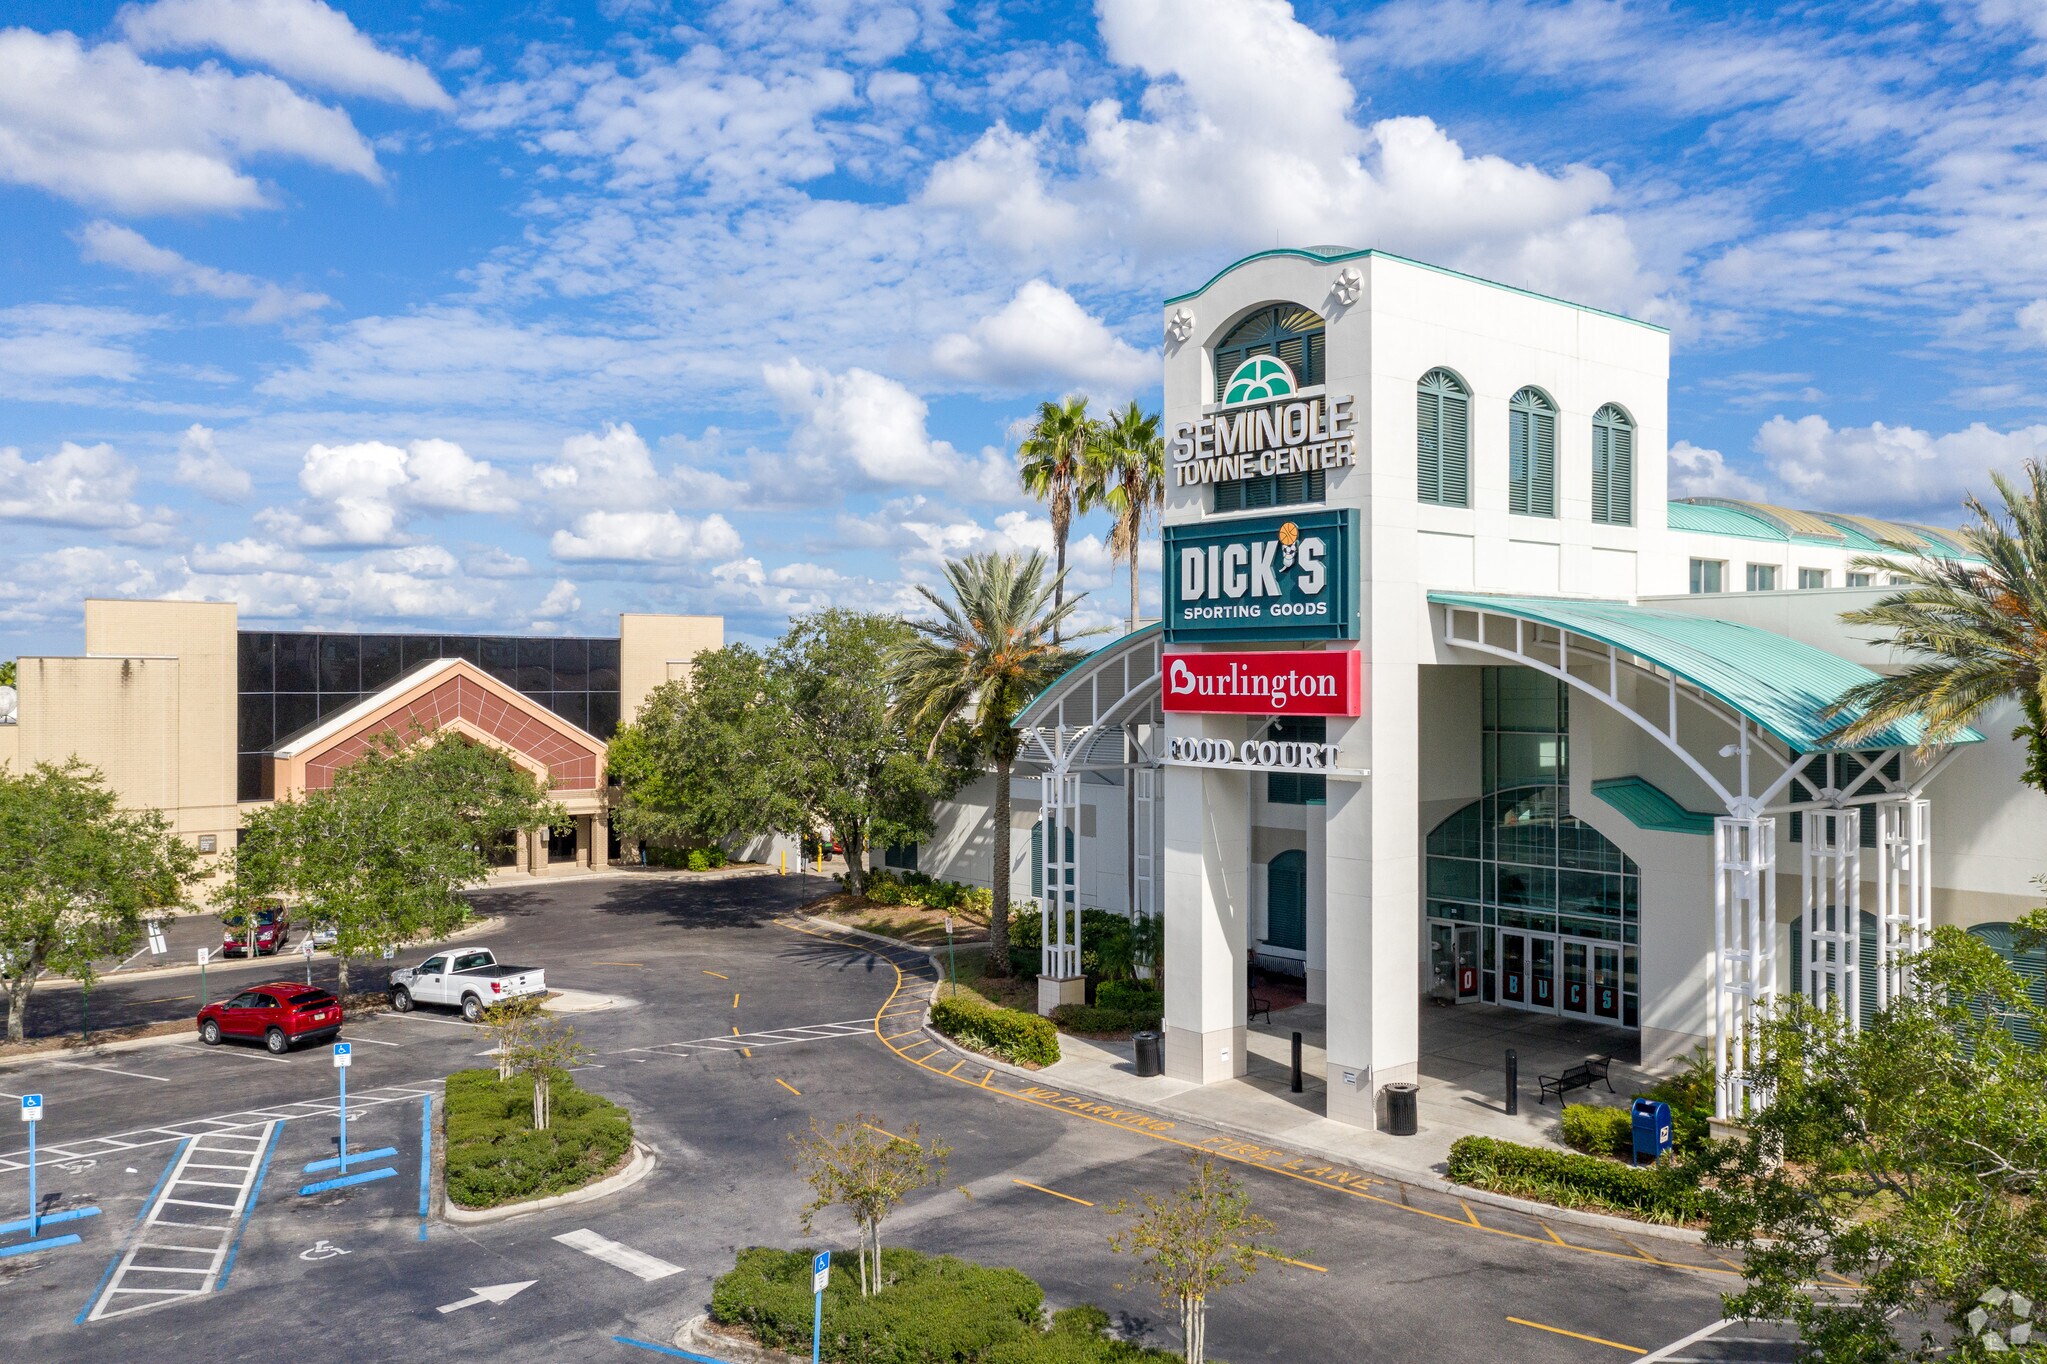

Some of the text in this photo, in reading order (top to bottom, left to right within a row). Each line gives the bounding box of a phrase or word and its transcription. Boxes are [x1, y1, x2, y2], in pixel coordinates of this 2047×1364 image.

[1172, 394, 1354, 463] SEMINOLE
[1173, 440, 1357, 487] TOWNE CENTER
[1181, 534, 1328, 600] DICK'S
[1184, 602, 1328, 620] SPORTING GOODS
[1169, 658, 1338, 709] Burlington
[1167, 737, 1344, 770] FOOD COURT
[1018, 1086, 1176, 1131] NO PARKING
[1200, 1136, 1385, 1191] FIRE LANE
